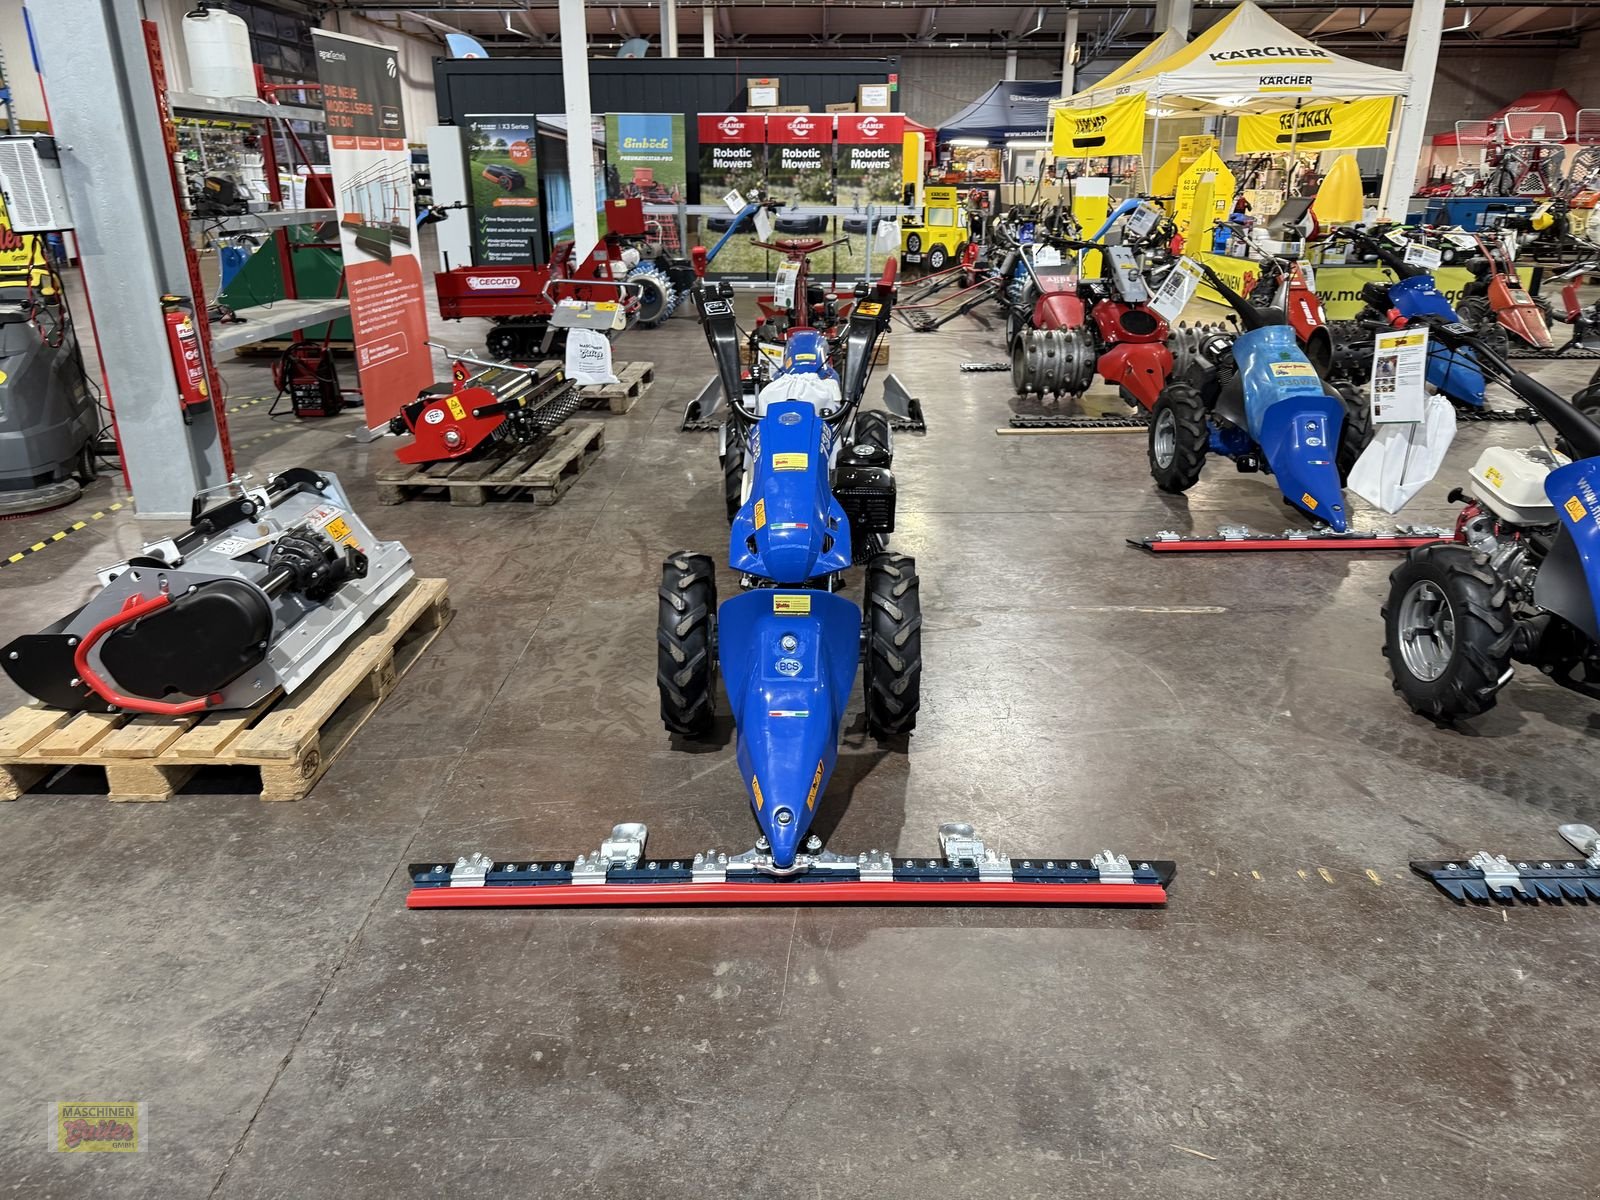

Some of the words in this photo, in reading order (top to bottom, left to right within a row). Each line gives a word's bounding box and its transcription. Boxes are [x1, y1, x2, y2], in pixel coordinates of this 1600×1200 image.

[1209, 46, 1329, 61] KÄRCHER
[1259, 75, 1313, 86] KÄRCHER
[323, 84, 338, 98] DIE
[338, 86, 358, 100] NEUE
[717, 122, 745, 130] CRAMER
[787, 122, 815, 130] CRAMER
[623, 136, 669, 149] Einböck
[713, 147, 752, 158] Robotic
[782, 148, 821, 158] Robotic
[851, 148, 890, 158] Robotic
[713, 158, 753, 168] Mowers
[781, 159, 822, 169] Mowers
[850, 159, 891, 169] Mowers
[479, 278, 518, 286] CECCATO
[779, 661, 800, 671] BCS
